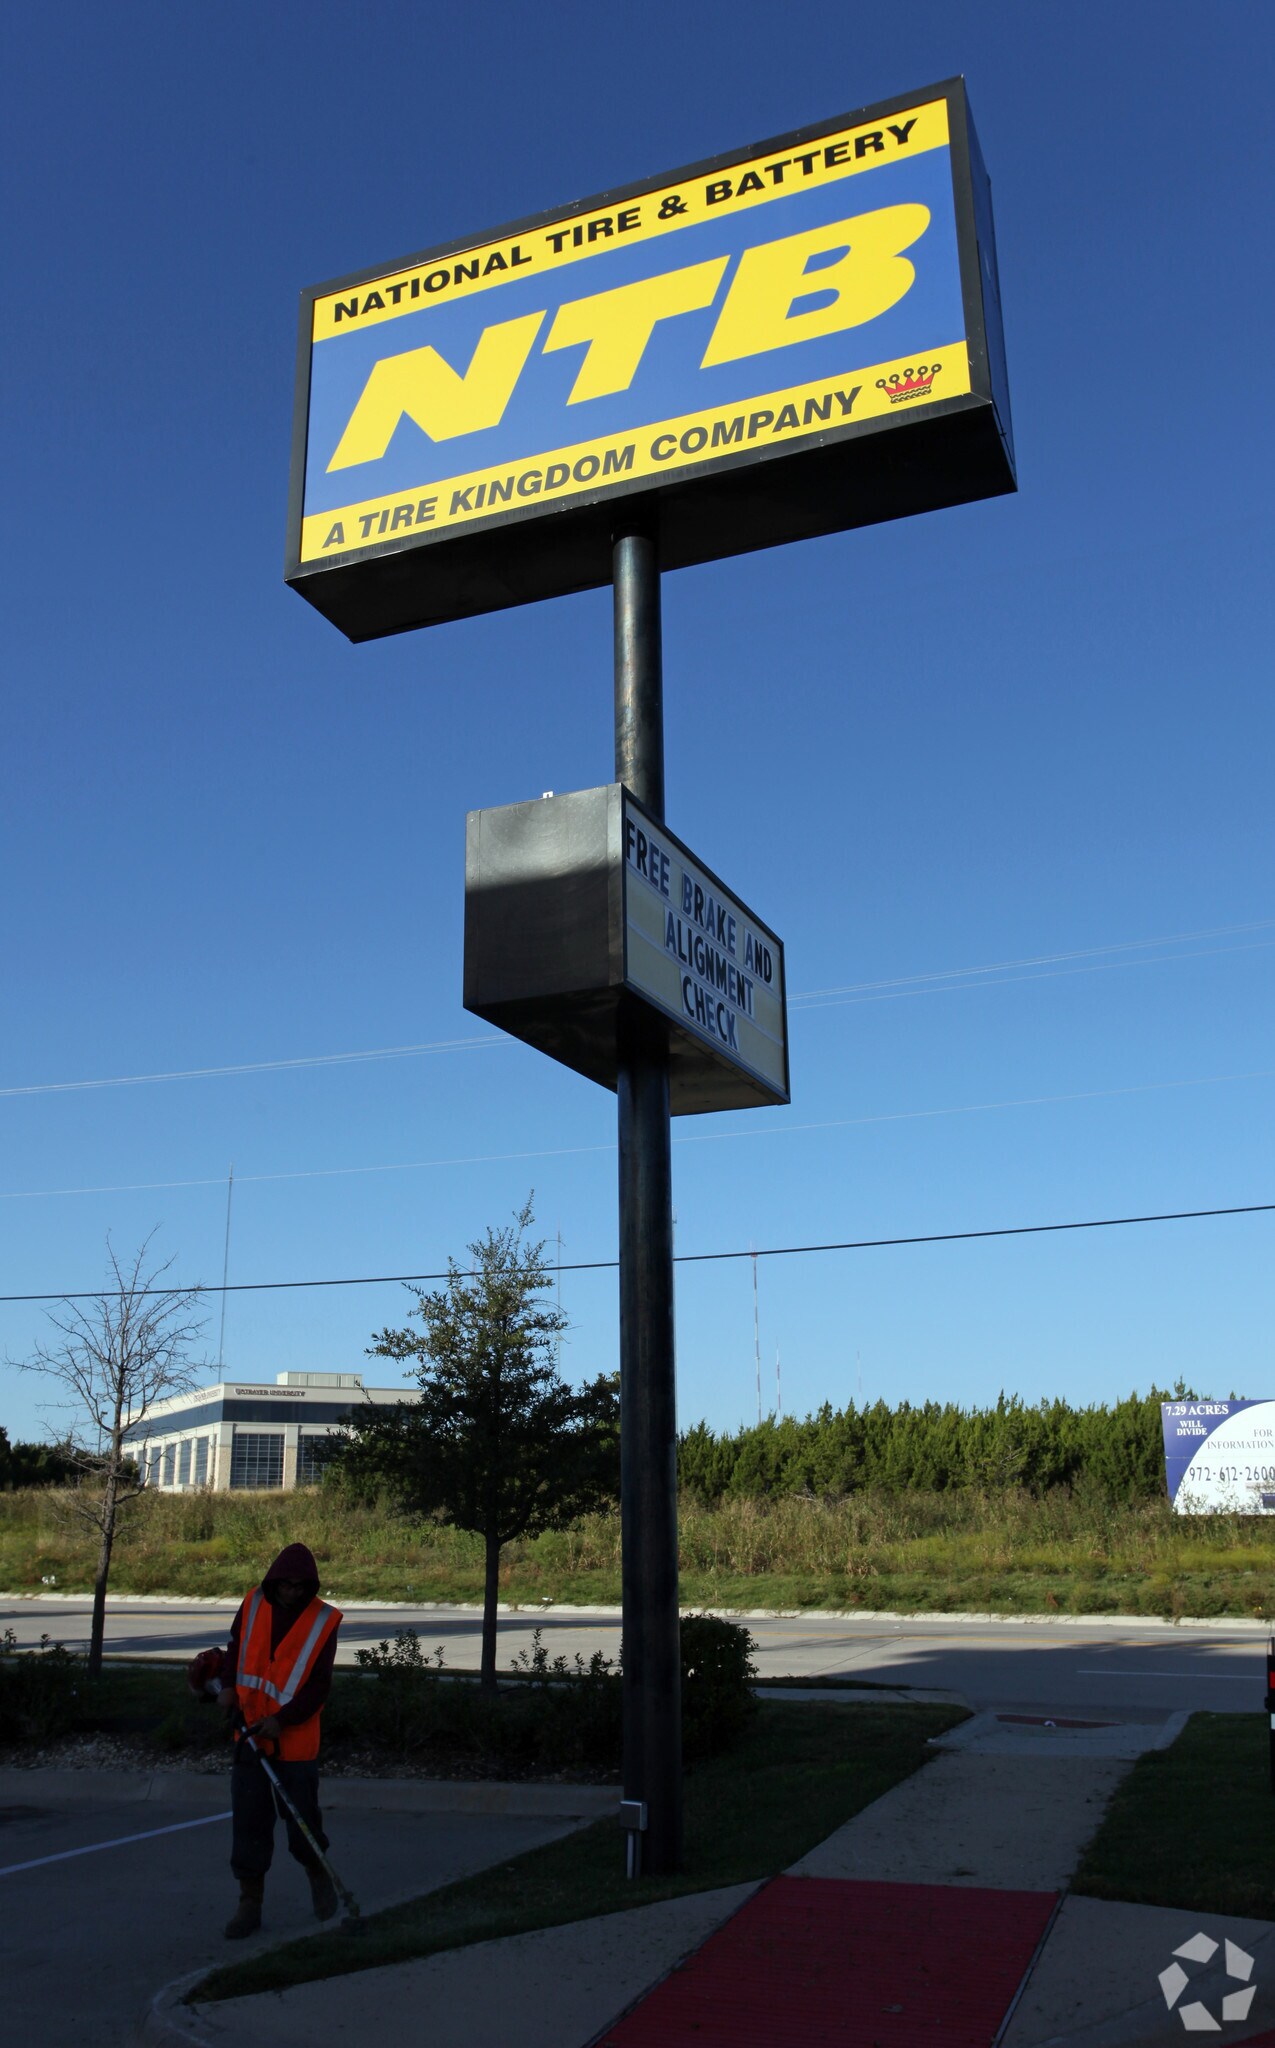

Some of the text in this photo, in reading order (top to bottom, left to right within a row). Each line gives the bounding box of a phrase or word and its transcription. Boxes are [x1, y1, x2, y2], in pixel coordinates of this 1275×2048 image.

[334, 117, 919, 323] NATIONAL TIRE & BATTERY
[325, 203, 931, 474] NTB
[322, 385, 863, 549] A TIRE KINGDOM COMPANY
[626, 817, 773, 984] FREE BRAKE AND
[666, 912, 753, 1015] ALIGNMENT
[682, 975, 738, 1050] CHECK
[1166, 1404, 1229, 1416] 7.29 ACRES
[1177, 1427, 1207, 1436] DIVIDE
[1180, 1420, 1203, 1428] WILL
[1207, 1440, 1274, 1449] INFORMATION
[1253, 1428, 1273, 1437] FOR
